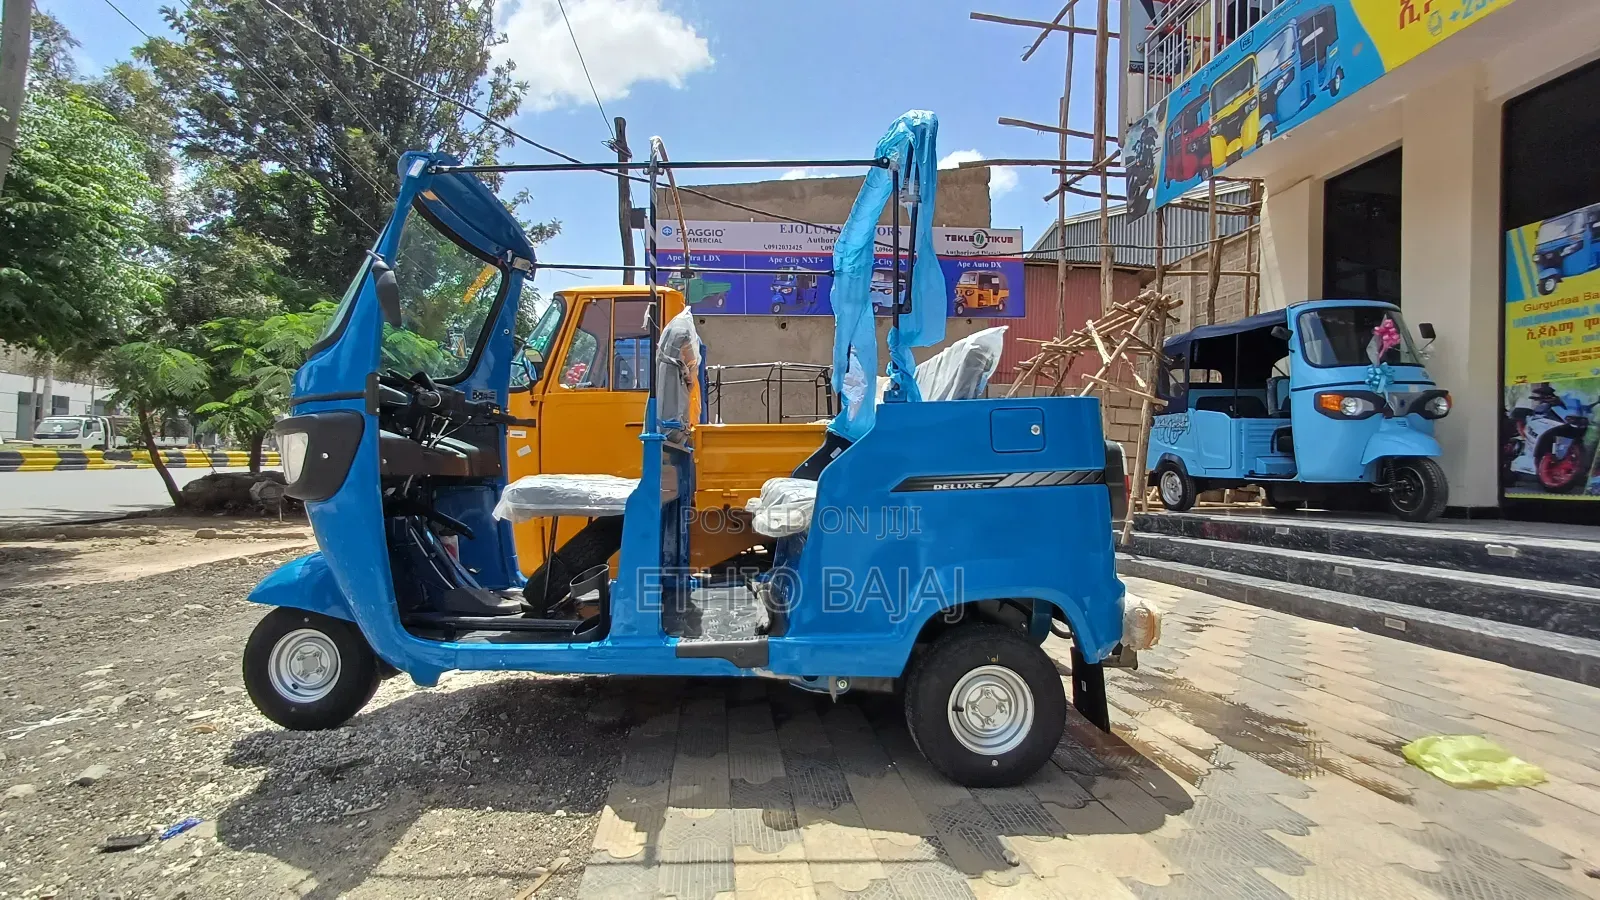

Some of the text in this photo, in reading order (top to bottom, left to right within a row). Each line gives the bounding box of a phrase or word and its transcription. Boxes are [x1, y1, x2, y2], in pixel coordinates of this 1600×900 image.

[676, 228, 725, 237] PAGGIO
[667, 254, 682, 262] Ape
[768, 256, 783, 265] Ape
[784, 256, 800, 265] City
[957, 261, 971, 269] Ape
[933, 482, 983, 490] DELUXE
